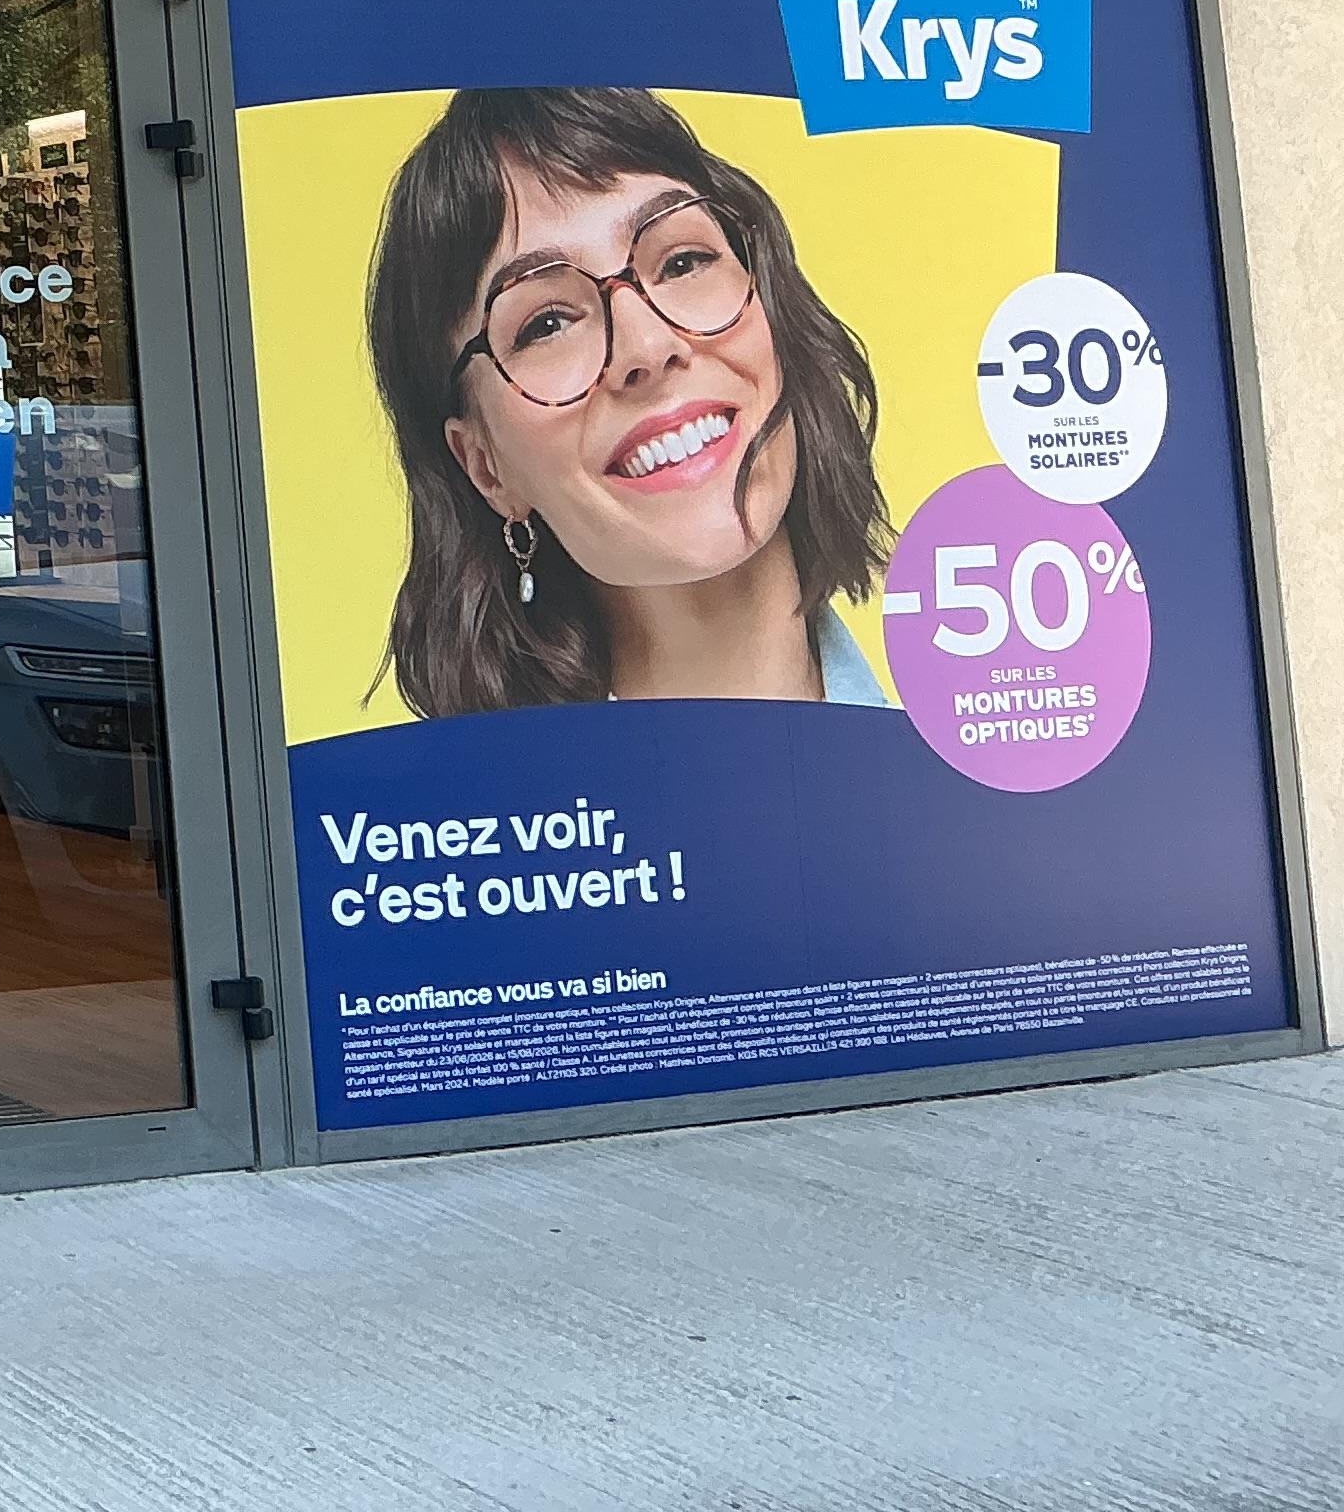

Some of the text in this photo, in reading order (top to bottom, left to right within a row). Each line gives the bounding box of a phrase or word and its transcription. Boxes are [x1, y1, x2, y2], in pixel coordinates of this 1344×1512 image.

[1028, 431, 1128, 449] MONTURES
[1054, 416, 1099, 427] SUR LES
[883, 539, 1147, 657] -50%
[990, 665, 1056, 684] SUR LES
[954, 685, 1097, 717] MONTURES
[320, 797, 625, 864] Venez voir,
[331, 851, 686, 926] c'est ouvert !
[339, 968, 666, 1016] La confiance vous va si bien
